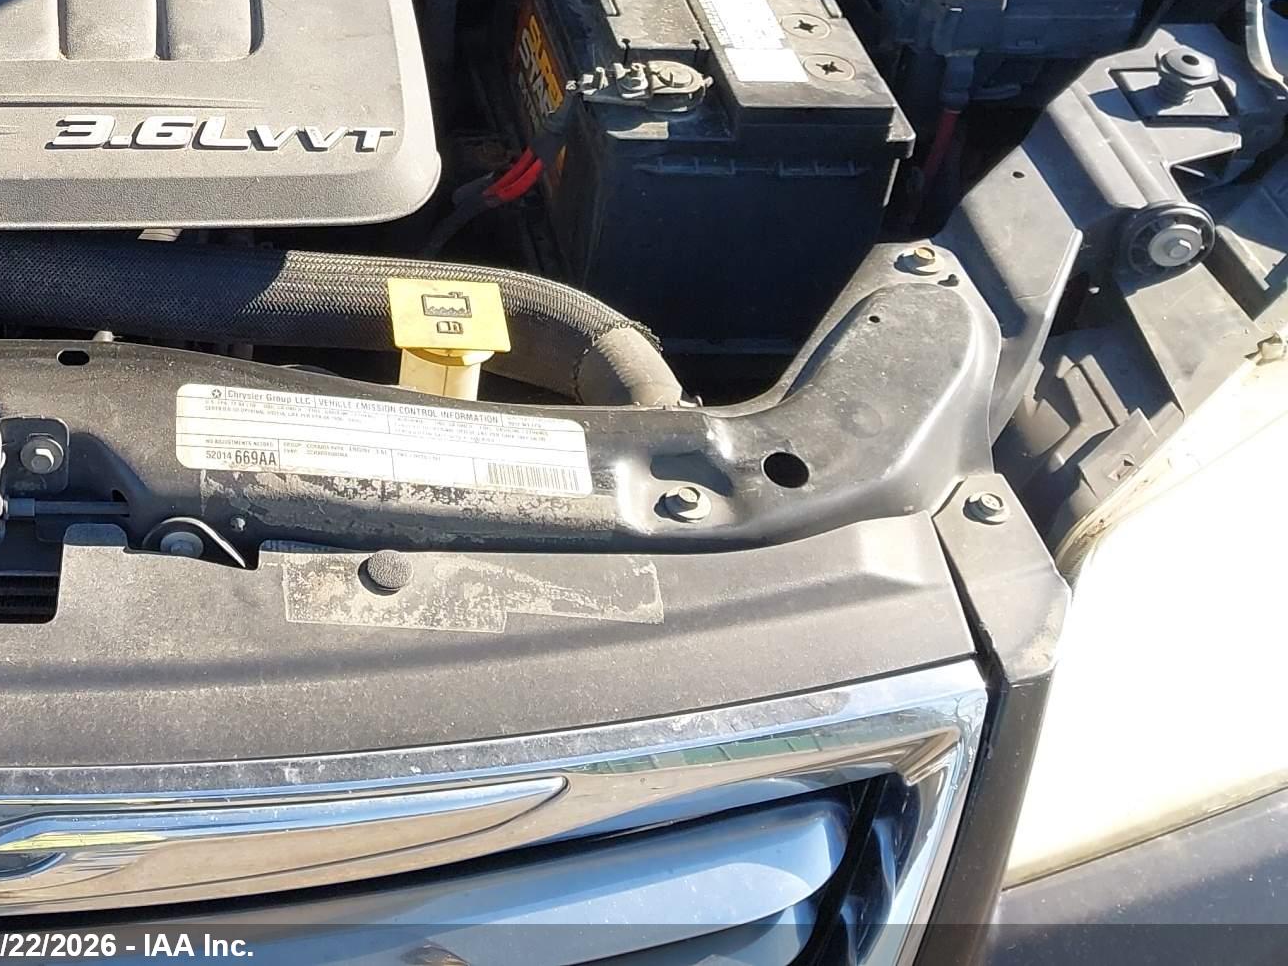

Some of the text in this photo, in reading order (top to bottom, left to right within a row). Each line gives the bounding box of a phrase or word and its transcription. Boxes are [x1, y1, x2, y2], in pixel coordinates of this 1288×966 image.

[227, 389, 263, 401] Chrysler
[266, 393, 292, 404] Group
[318, 398, 352, 410] VEHICLE
[356, 402, 396, 413] EMISSION
[399, 406, 436, 418] CONTROL
[440, 410, 499, 423] INFORMATION
